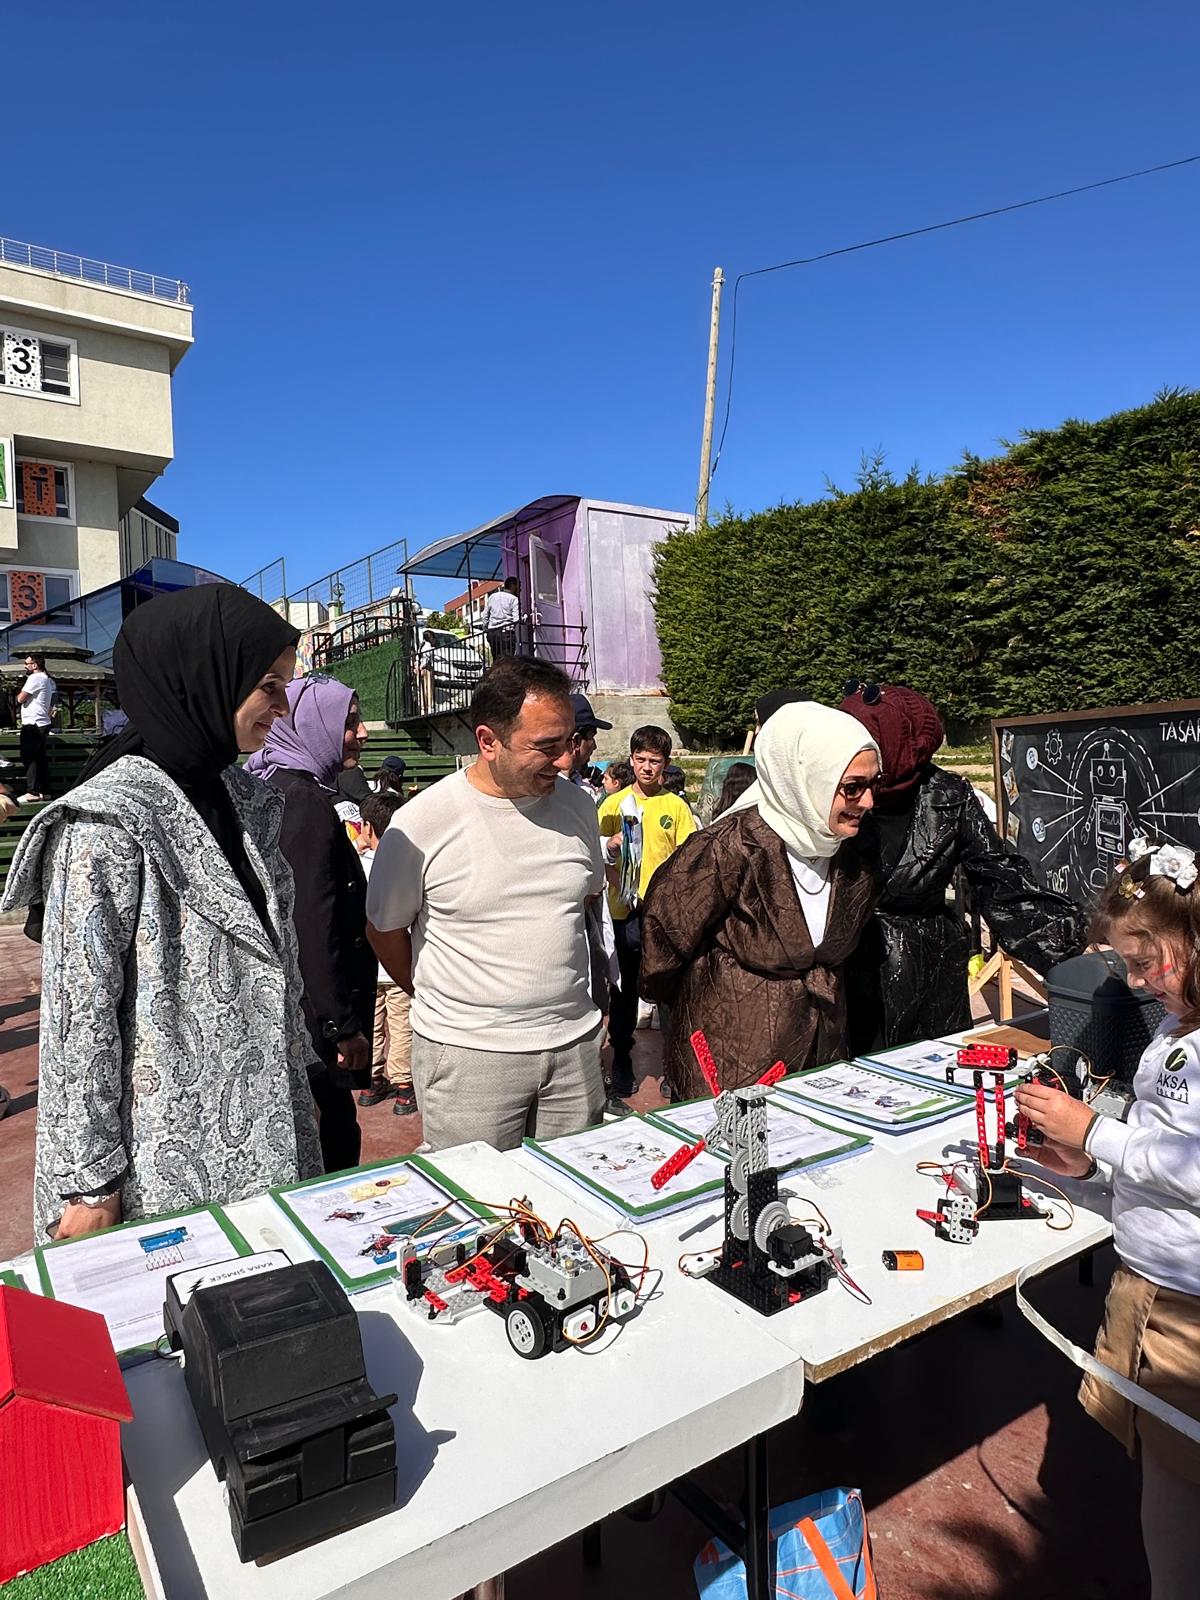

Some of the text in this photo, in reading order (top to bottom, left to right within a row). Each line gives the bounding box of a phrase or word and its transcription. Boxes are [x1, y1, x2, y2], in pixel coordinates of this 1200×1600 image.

[12, 347, 31, 374] 3
[18, 585, 38, 611] 3
[1157, 1072, 1188, 1092] AKSA
